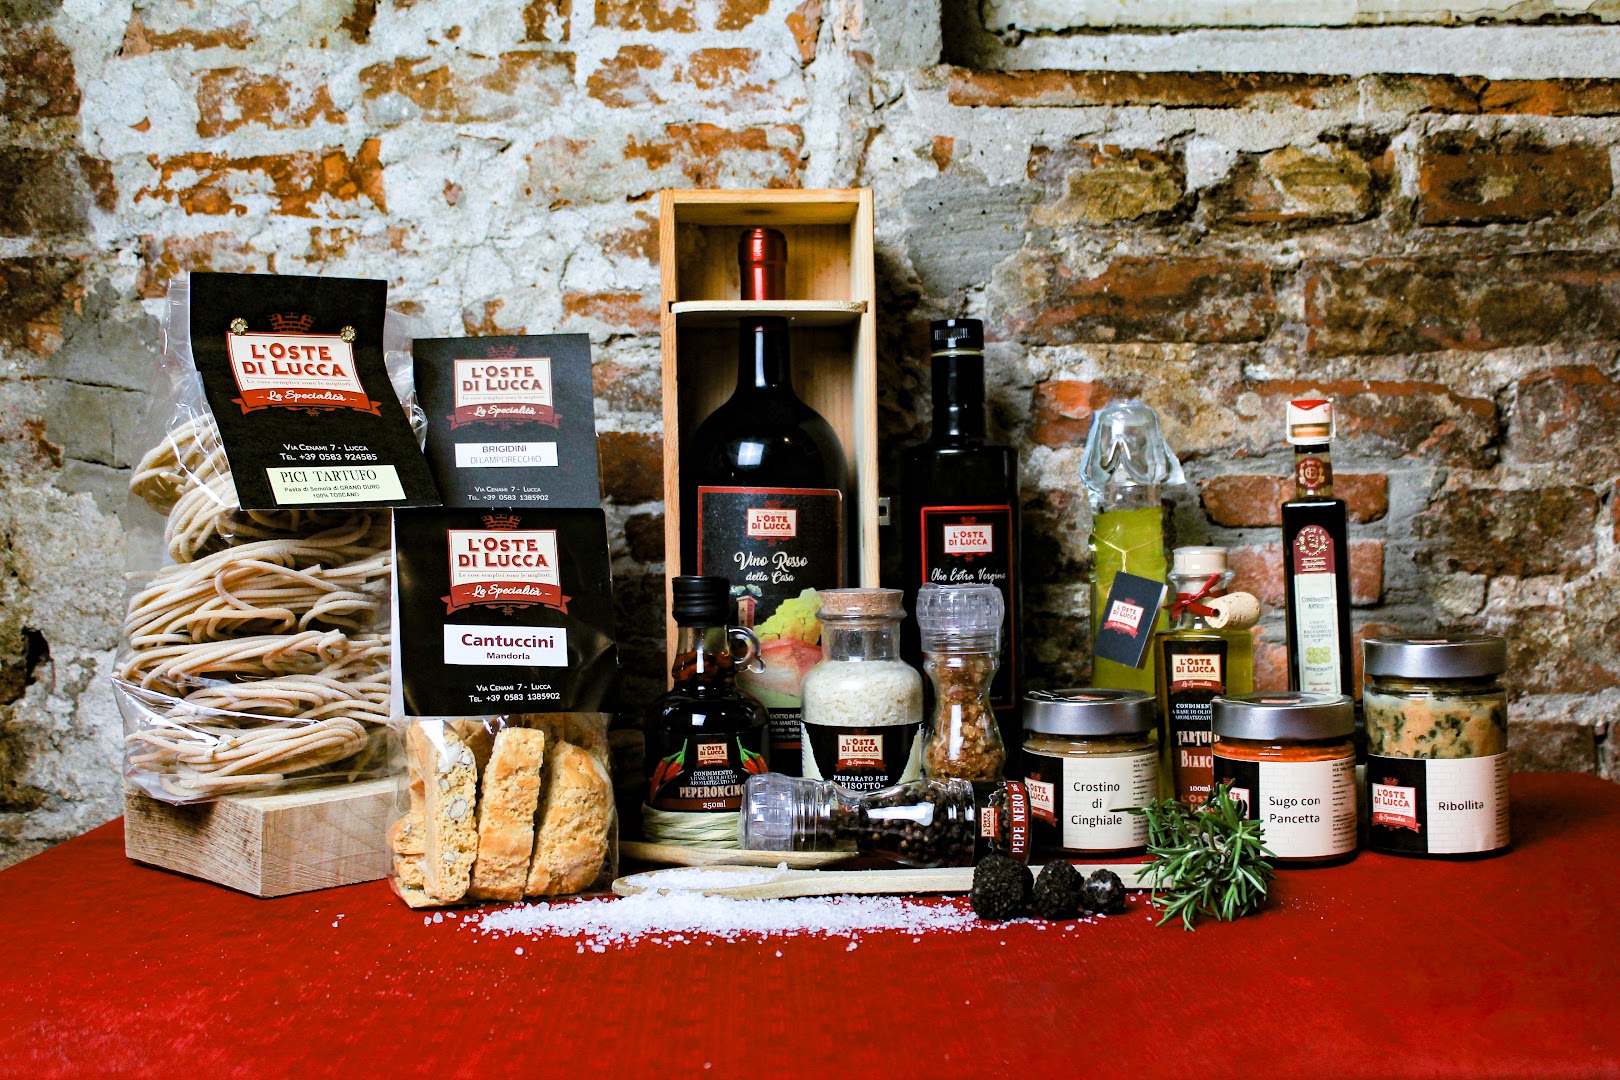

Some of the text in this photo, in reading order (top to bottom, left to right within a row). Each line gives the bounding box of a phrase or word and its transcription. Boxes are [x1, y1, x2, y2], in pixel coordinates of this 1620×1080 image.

[251, 342, 332, 361] L'OSTE
[242, 360, 348, 377] DI LUCCA
[472, 366, 534, 378] L'OSTE
[462, 379, 543, 392] DI LUCCA
[285, 390, 346, 402] Specialità
[488, 405, 536, 418] Specialità
[482, 445, 527, 453] BRIGIDINI
[470, 456, 541, 464] DI LAMPORECCHIO
[280, 470, 377, 482] PICI TARTUFO
[756, 515, 788, 523] L'OSTE
[764, 522, 792, 530] LUCCA
[953, 531, 984, 539] L'OSTE
[468, 537, 538, 552] L'OSTE
[960, 538, 988, 546] LUCCA
[458, 553, 549, 567] DI LUCCA
[734, 551, 808, 572] Vino Rosso
[746, 570, 795, 584] della Casa
[931, 567, 1006, 584] Olio Extra Vergine
[488, 584, 542, 598] Specialità
[461, 633, 554, 648] Cantuccini
[486, 652, 530, 660] Mandorla
[527, 693, 560, 701] 1385902
[1181, 749, 1213, 768] BIANC
[679, 784, 745, 798] PEPERONCINO
[1073, 782, 1120, 792] Crostino
[1377, 789, 1405, 799] L'OSTE
[703, 800, 726, 809] 250ml
[1012, 794, 1025, 822] NERO
[1092, 799, 1102, 809] di
[1269, 796, 1321, 809] Sugo con
[1374, 796, 1410, 808] DI LUCCA
[1438, 800, 1484, 811] Ribollita
[1071, 815, 1123, 828] Cinghiale
[1269, 813, 1320, 824] Pancetta
[1012, 827, 1025, 852] PEPE
